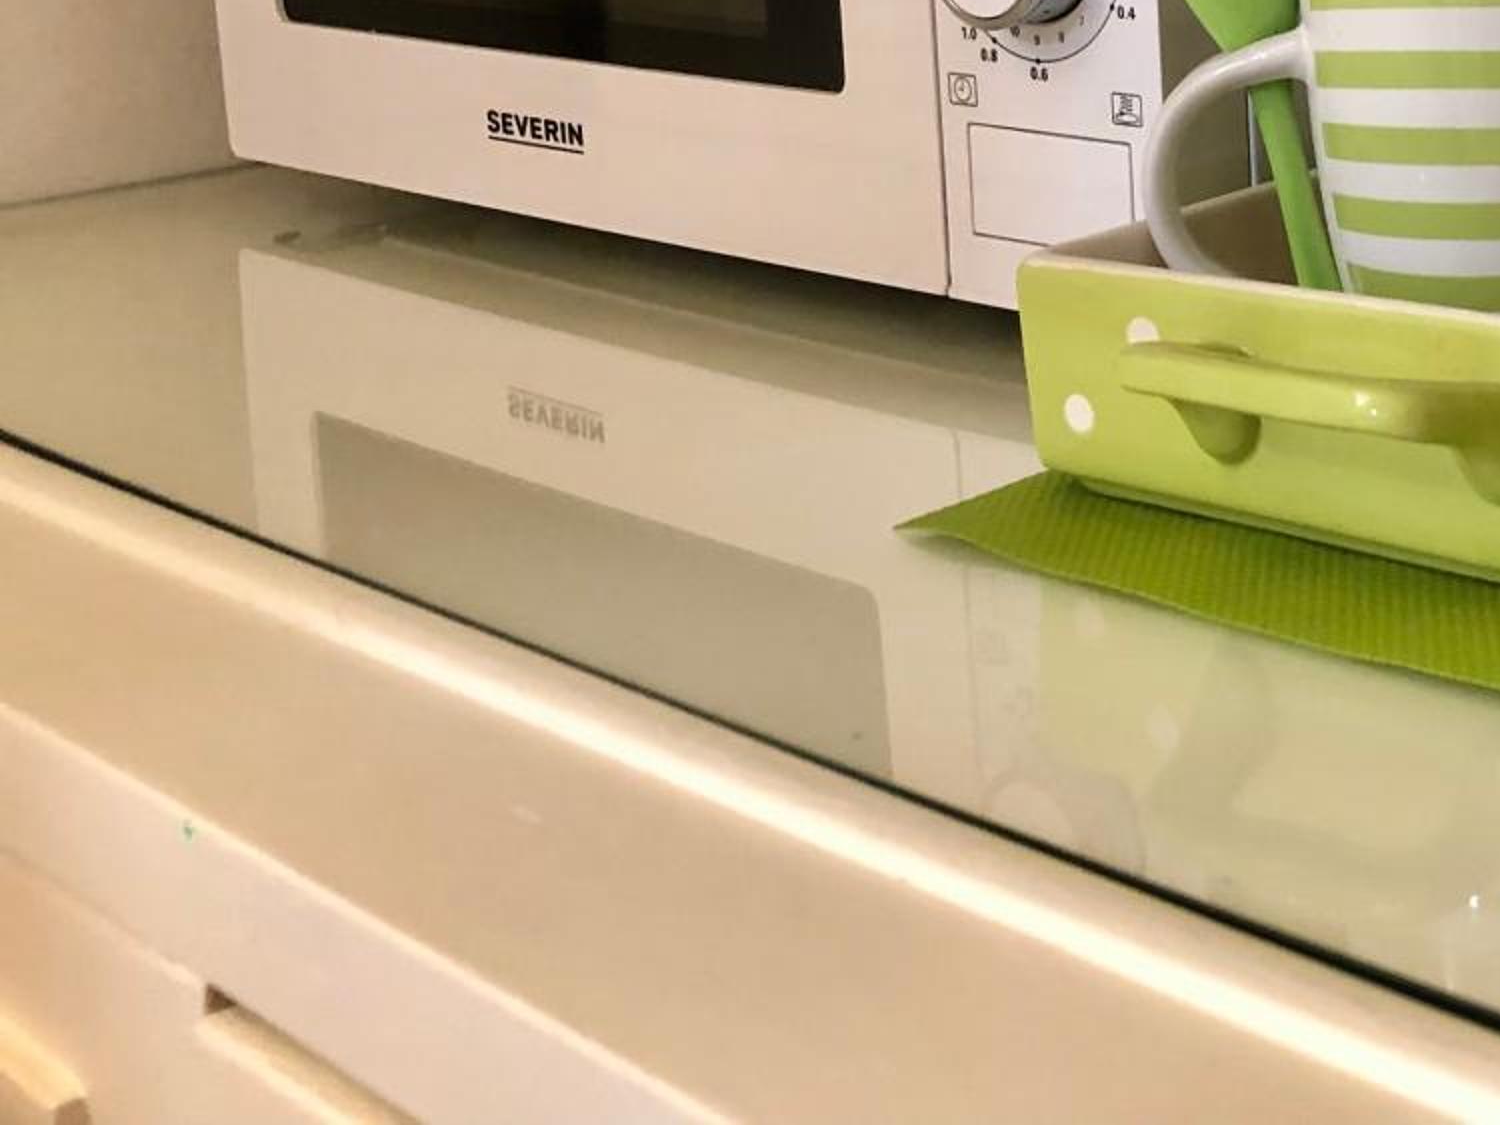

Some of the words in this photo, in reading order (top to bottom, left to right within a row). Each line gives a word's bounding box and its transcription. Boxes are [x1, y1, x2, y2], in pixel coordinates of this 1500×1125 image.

[1117, 5, 1137, 21] 0.4
[961, 26, 978, 41] 1.0
[980, 47, 999, 63] 0.8
[1029, 66, 1049, 82] 0.6
[486, 109, 585, 147] SEVERIN
